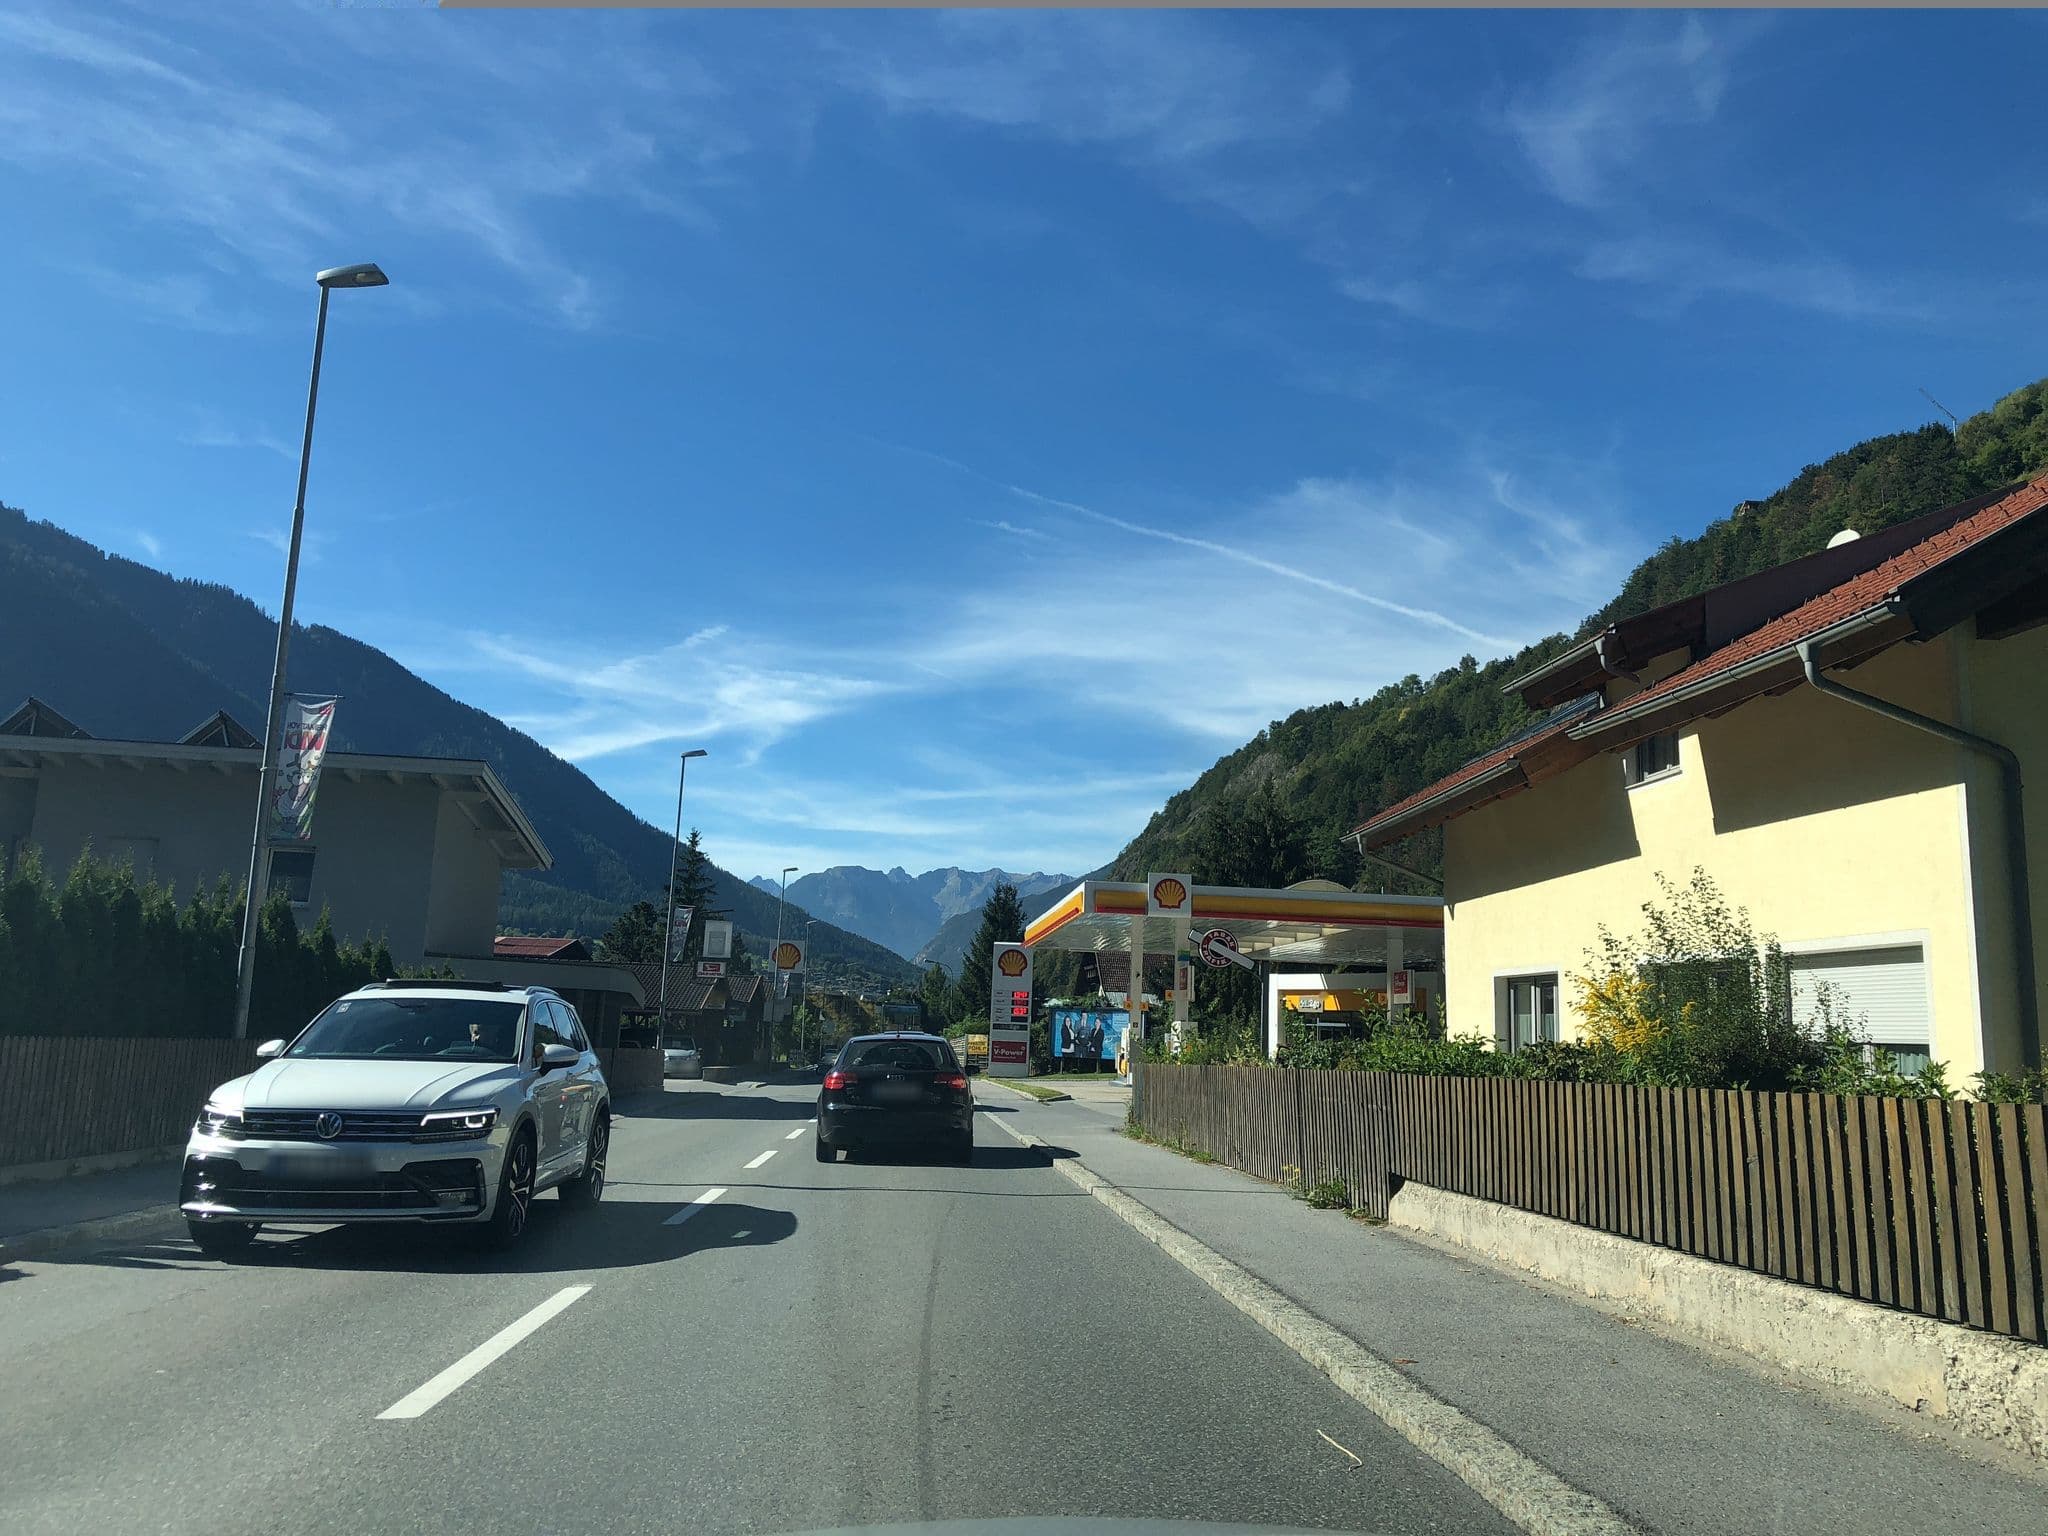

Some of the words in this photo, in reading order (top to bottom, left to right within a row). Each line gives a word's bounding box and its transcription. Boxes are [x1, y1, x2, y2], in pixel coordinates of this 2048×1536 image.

[1208, 932, 1235, 948] TABAK
[1202, 944, 1228, 965] TRAFIK
[994, 1048, 1024, 1057] V-Power
